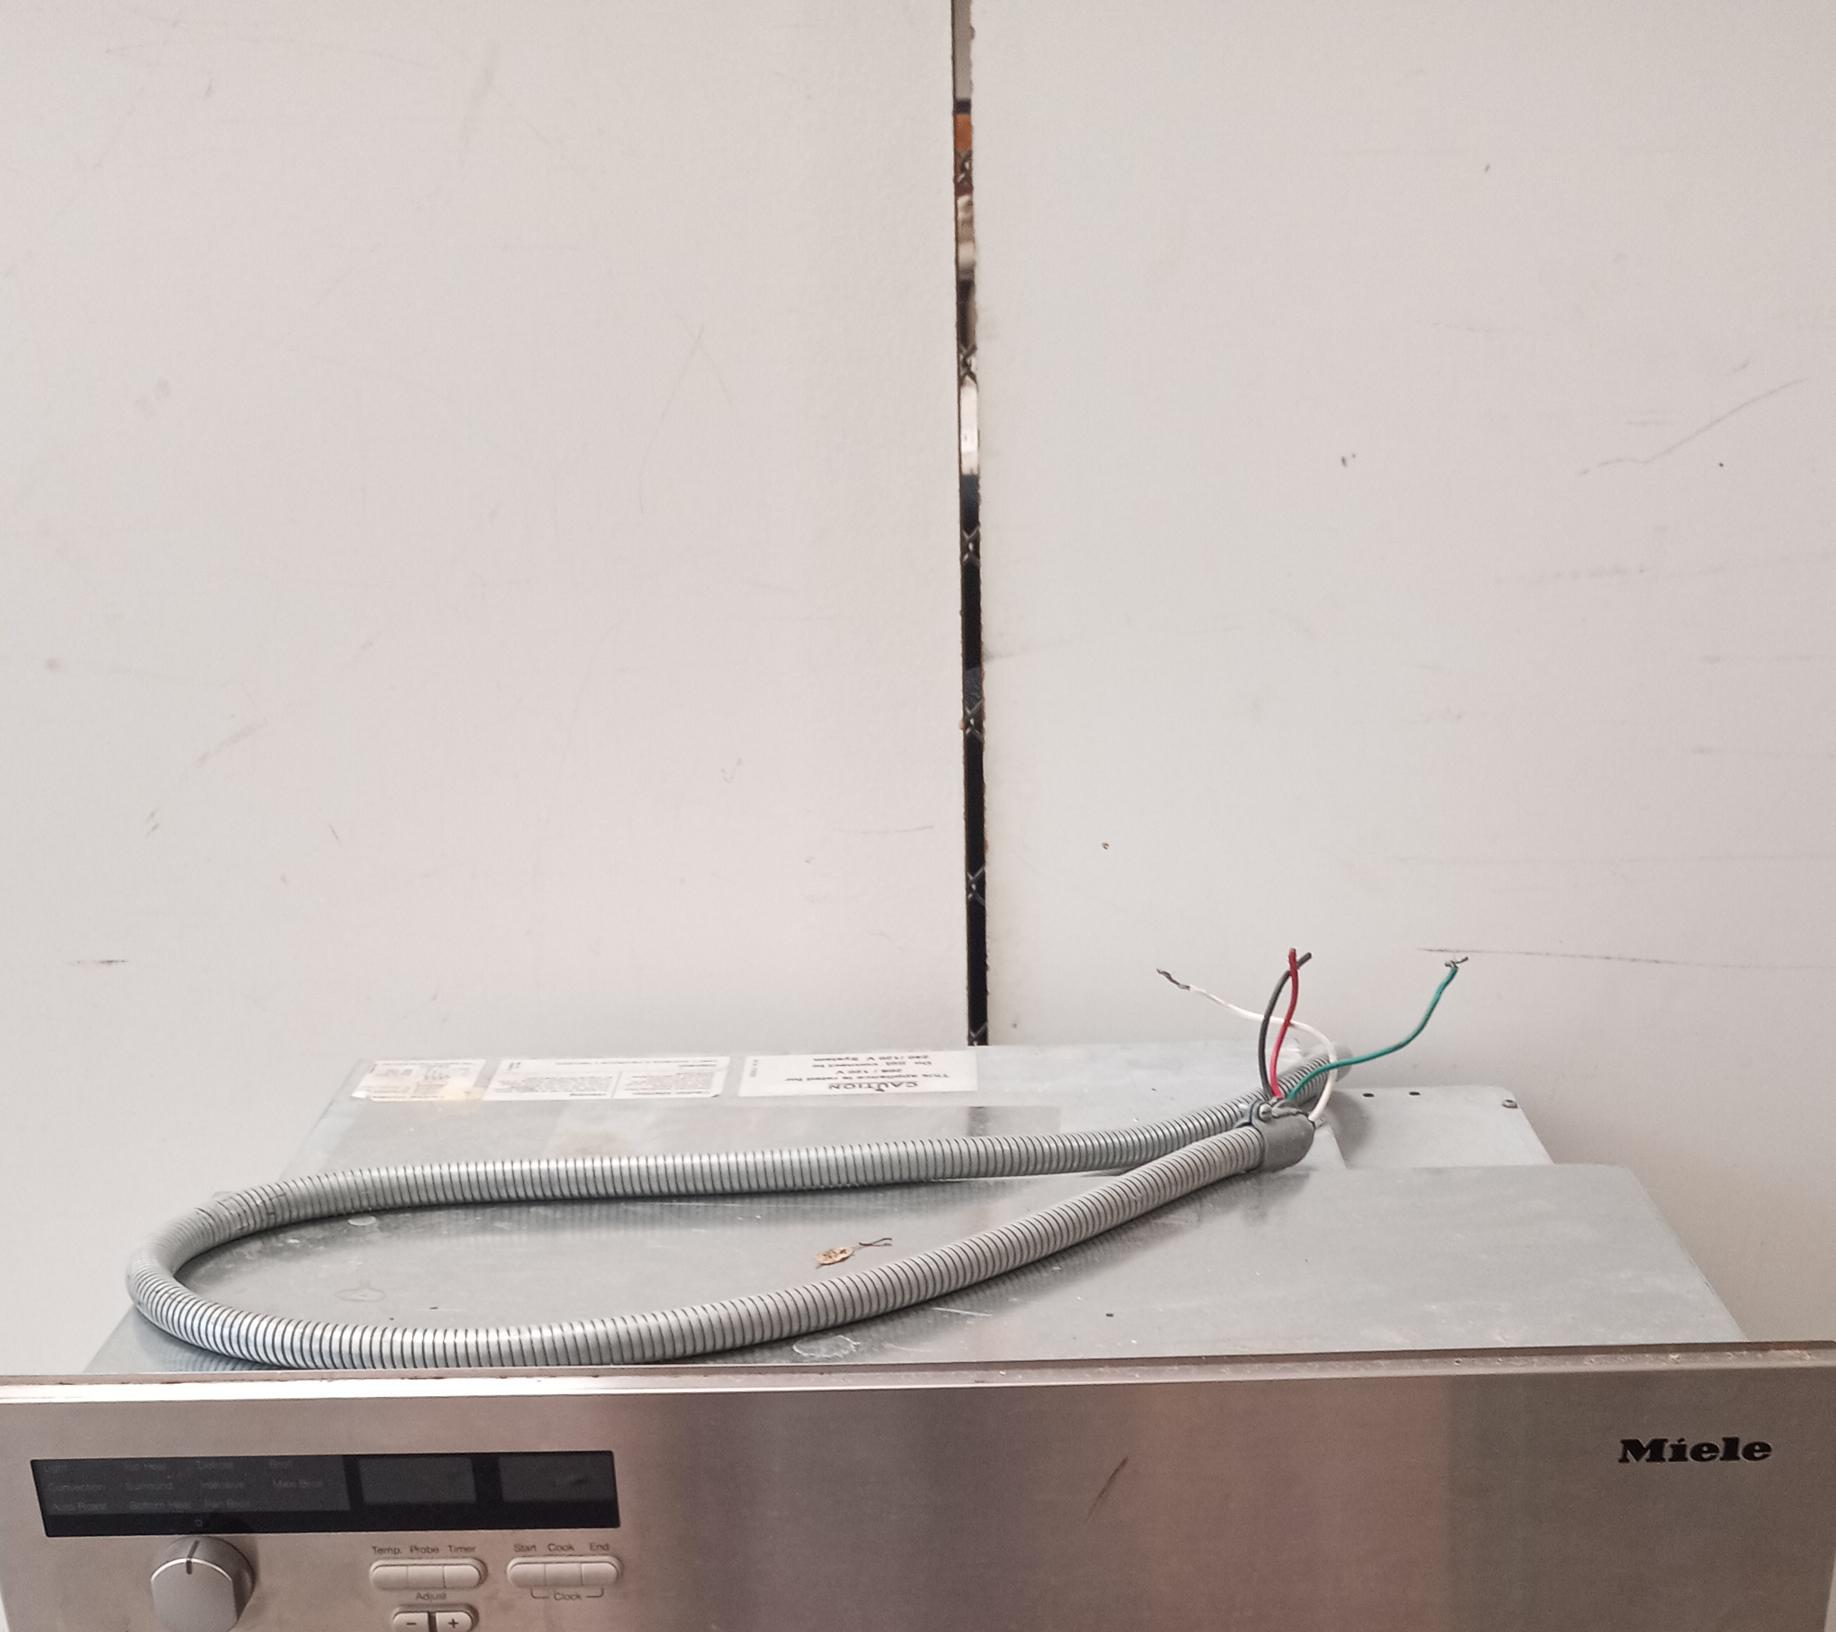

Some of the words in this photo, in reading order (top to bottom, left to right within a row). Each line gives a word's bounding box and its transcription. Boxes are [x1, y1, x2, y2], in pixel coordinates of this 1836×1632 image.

[827, 1081, 919, 1090] CAUTION
[1618, 1437, 1772, 1463] Miele
[372, 1546, 402, 1555] Temp.
[409, 1546, 440, 1554] Probe
[447, 1544, 477, 1553] Timer
[513, 1543, 537, 1552] Start
[547, 1543, 576, 1552] Cook
[589, 1543, 610, 1552] End
[415, 1592, 448, 1602] Adjust
[553, 1592, 583, 1601] Clock
